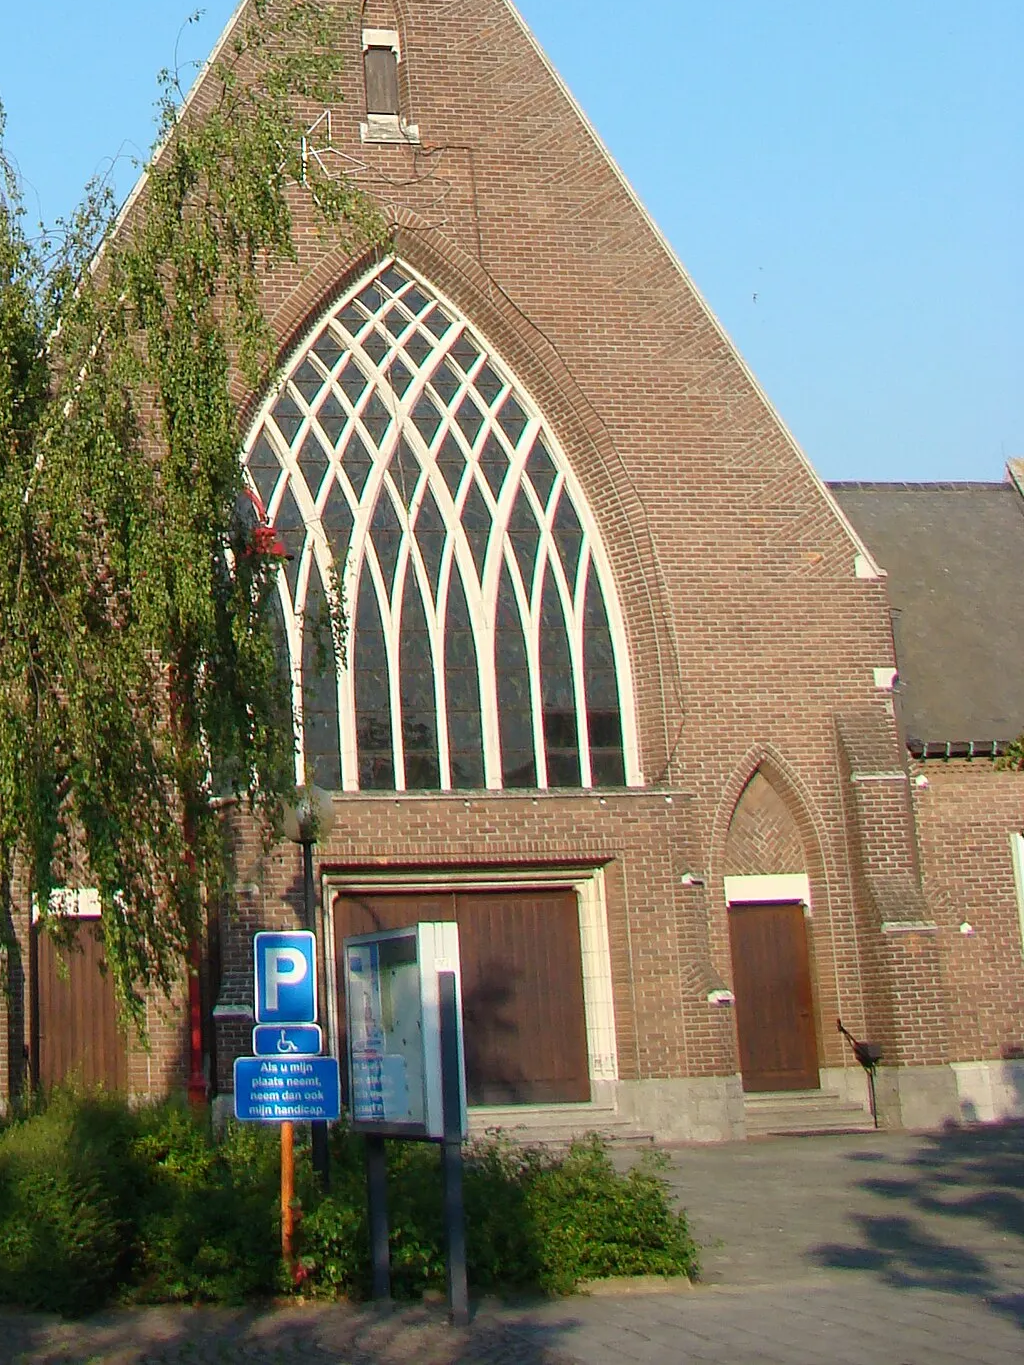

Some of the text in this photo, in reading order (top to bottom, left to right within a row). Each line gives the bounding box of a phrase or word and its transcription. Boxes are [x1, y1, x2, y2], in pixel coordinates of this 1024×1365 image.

[265, 947, 307, 1011] P
[260, 1062, 313, 1074] Als u mijn
[252, 1077, 322, 1088] plaats neemt,
[250, 1091, 324, 1101] neem dan ook
[249, 1105, 325, 1117] mijn handicap.
